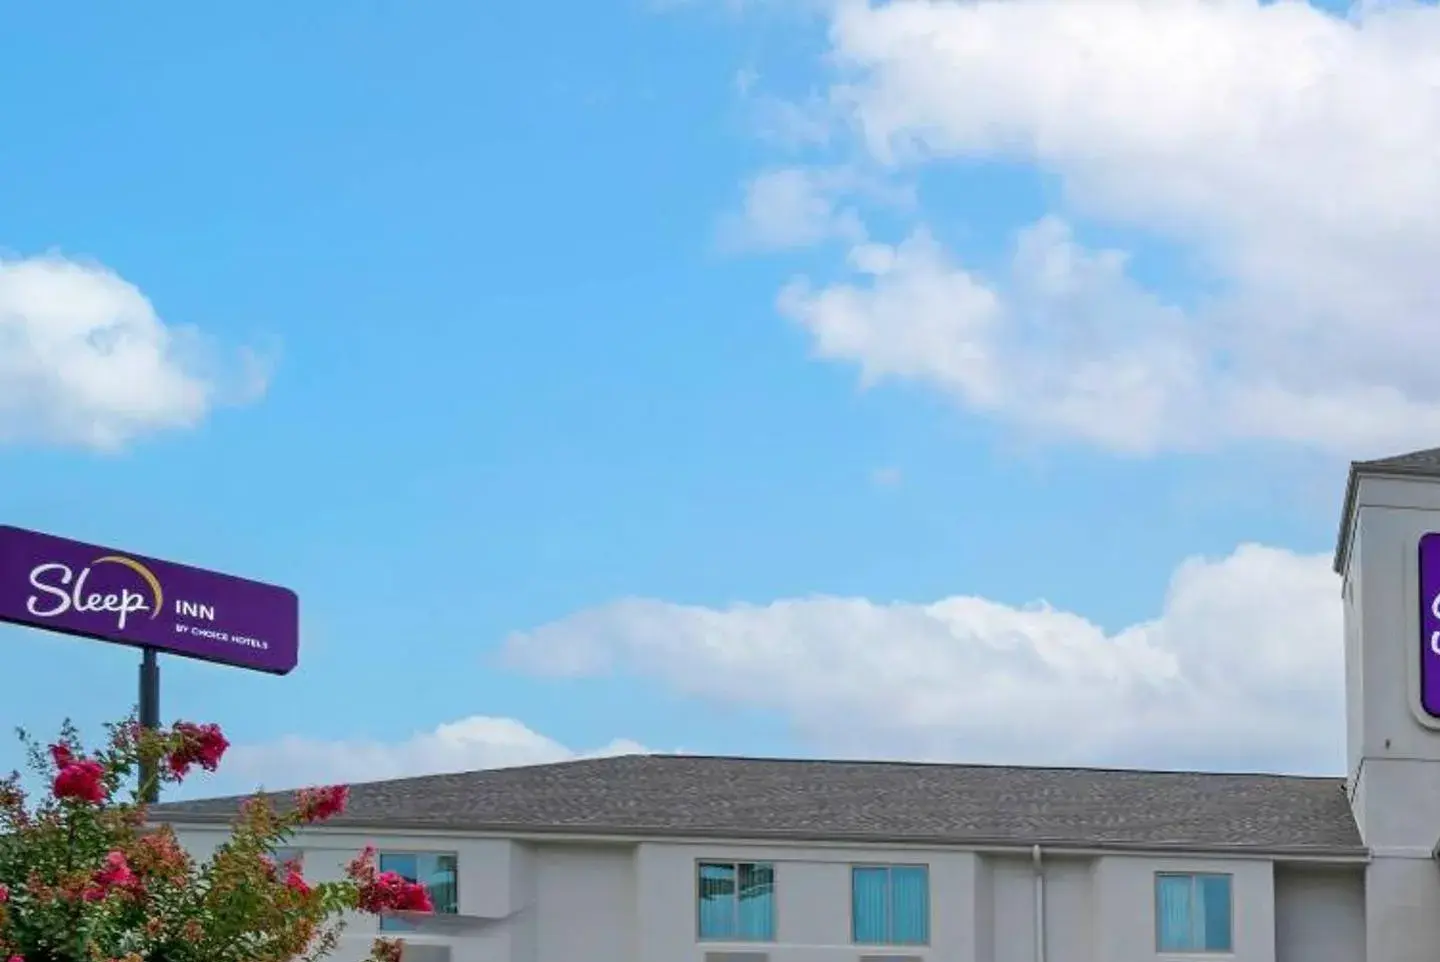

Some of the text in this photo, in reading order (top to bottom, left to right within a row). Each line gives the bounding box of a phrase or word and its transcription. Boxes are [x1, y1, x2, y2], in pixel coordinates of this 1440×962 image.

[26, 563, 150, 630] Sleep
[175, 599, 215, 621] INN
[175, 623, 268, 650] BY CHOICE HOTELS
